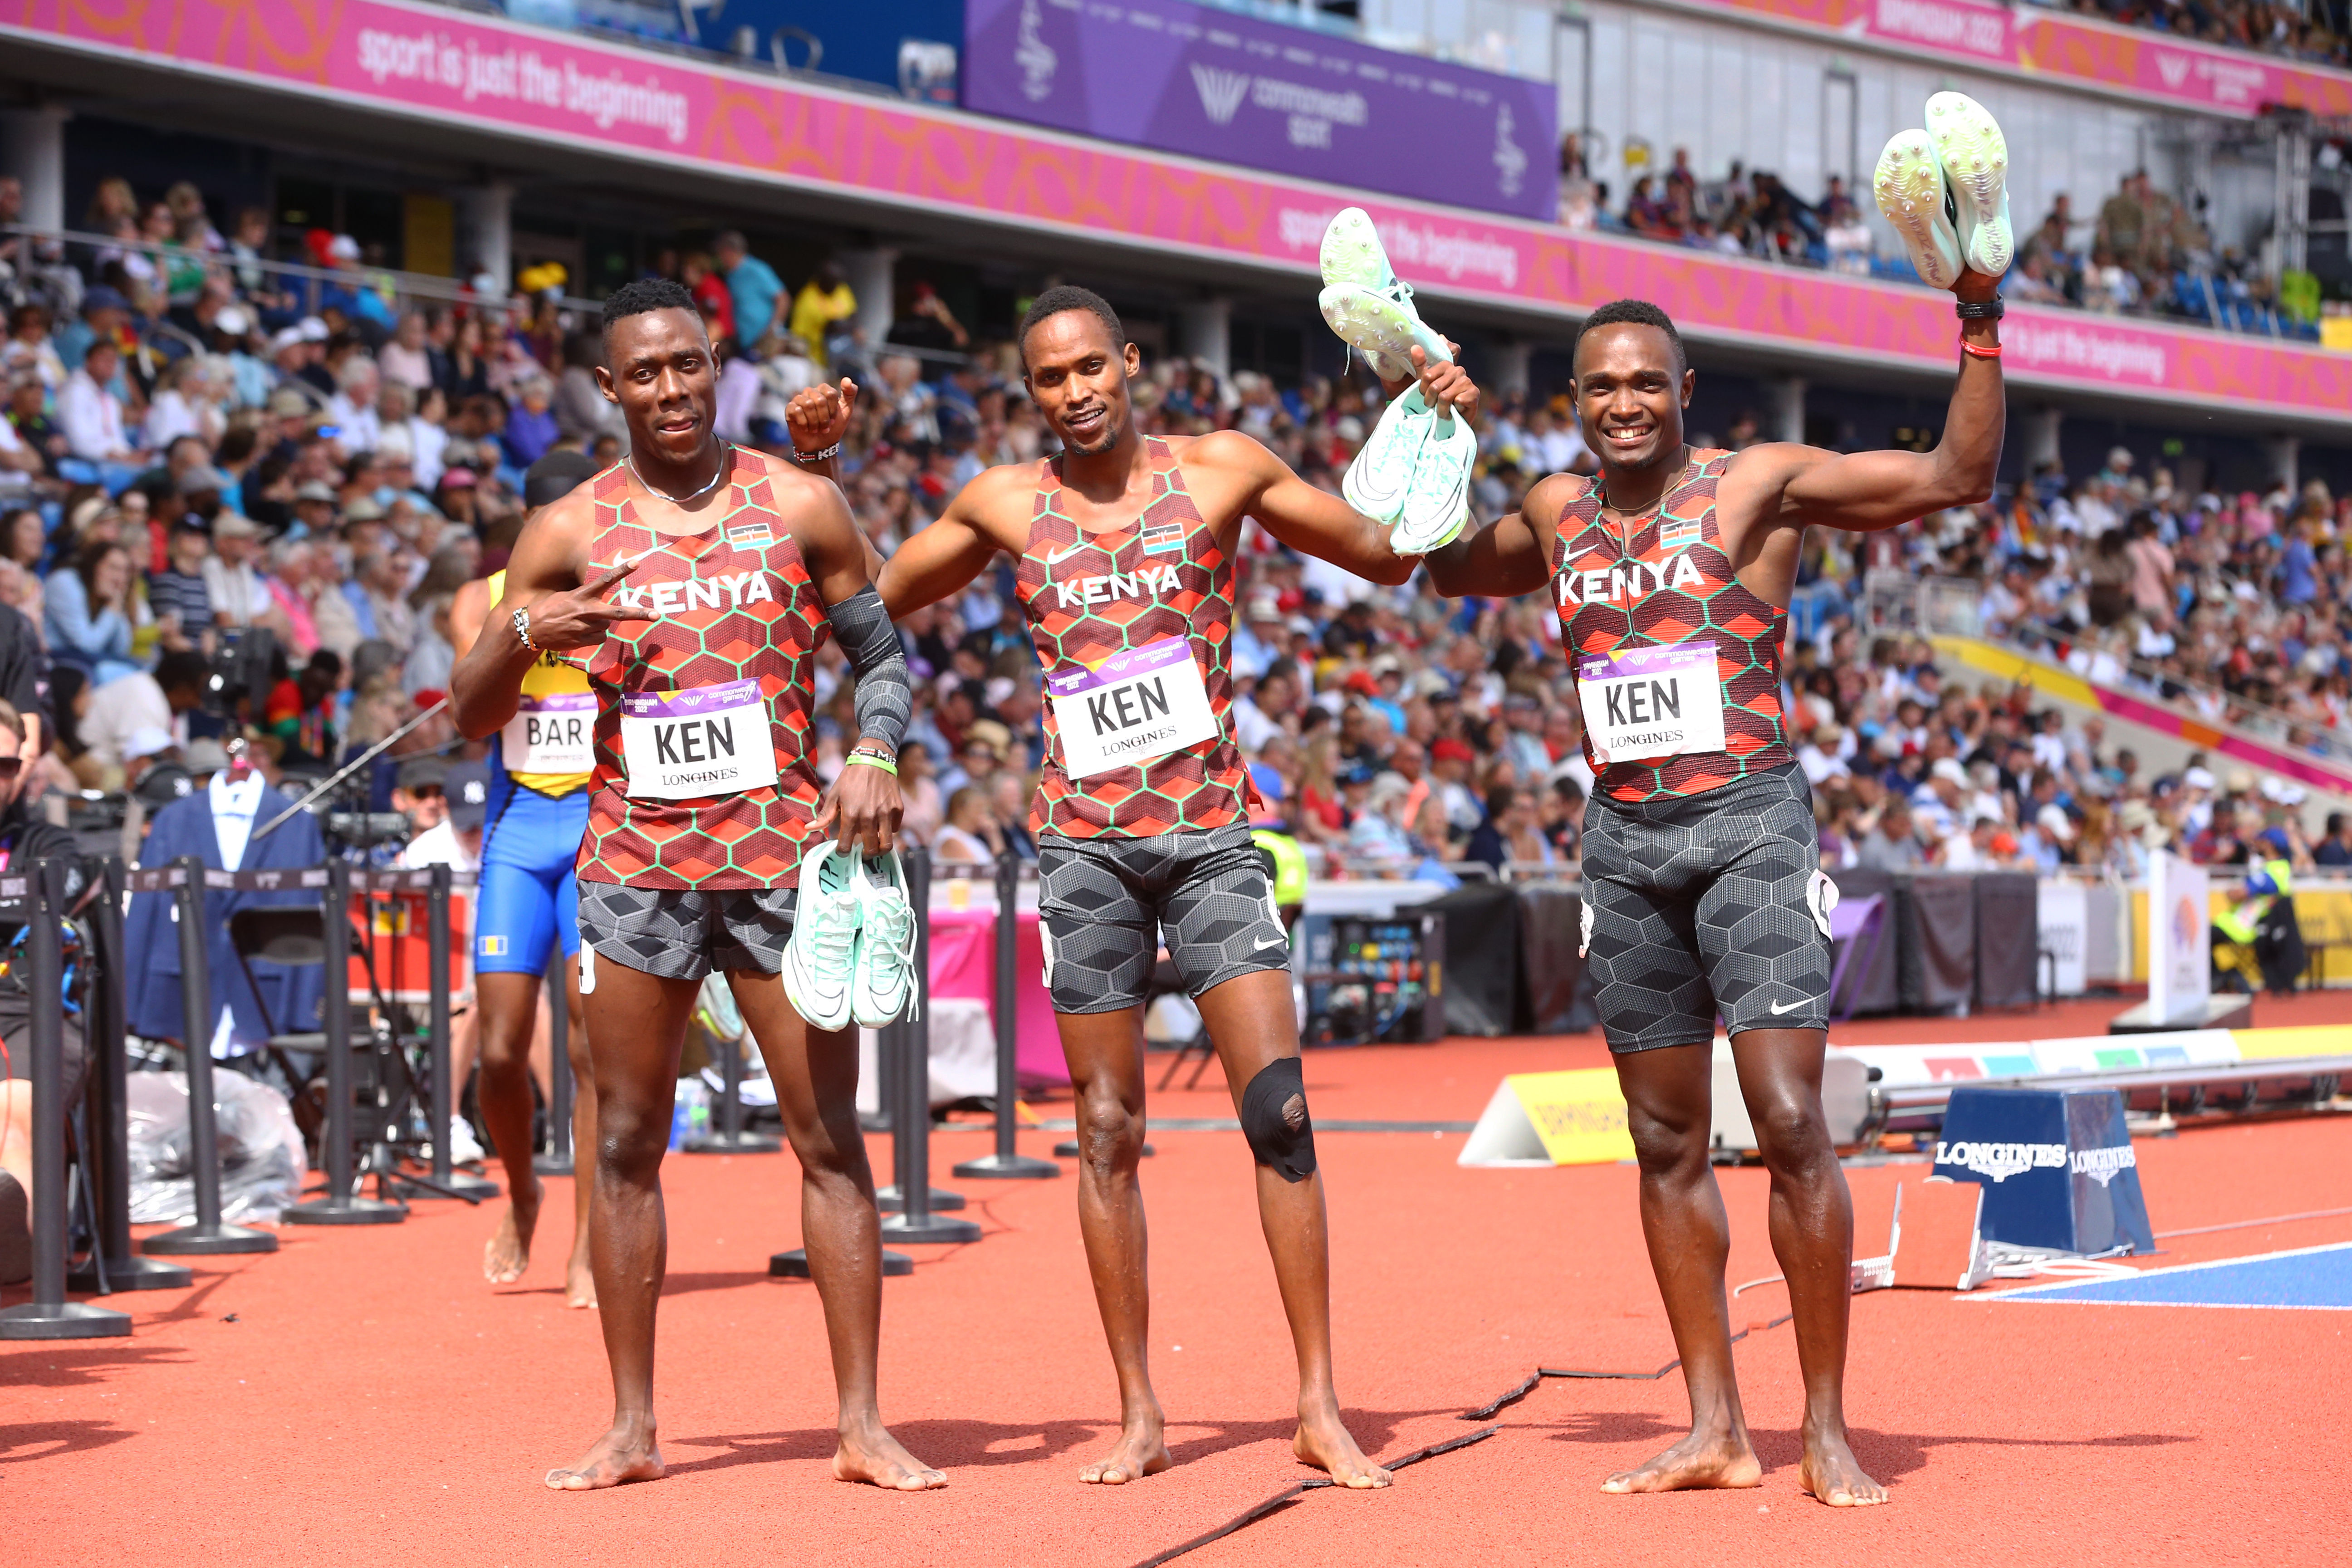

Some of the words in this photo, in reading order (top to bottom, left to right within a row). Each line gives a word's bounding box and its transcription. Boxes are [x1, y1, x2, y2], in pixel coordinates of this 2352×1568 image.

[357, 28, 436, 86] sport
[437, 30, 464, 88] is
[463, 37, 517, 103] just
[518, 50, 562, 108] the
[564, 57, 689, 144] beginning
[1425, 223, 1518, 289] beginning
[2089, 330, 2167, 384] beginning
[619, 570, 773, 615] KENYA
[1056, 564, 1183, 608] KENYA
[1559, 554, 1705, 606] KENYA
[1134, 641, 1185, 662] commonwealth
[1150, 651, 1173, 664] games
[1583, 659, 1609, 670] BIRMINGHAM
[1655, 647, 1710, 659] commonwealth
[1670, 655, 1695, 665] games
[1054, 671, 1088, 687] BIRMINGHAM
[1592, 667, 1602, 676] 2022
[708, 682, 756, 699] commonwea
[722, 693, 745, 704] games
[1066, 680, 1079, 691] 2022
[1087, 676, 1171, 736] KEN
[1605, 678, 1681, 727] KEN
[527, 718, 583, 745] BAR
[654, 716, 735, 764] KEN
[1102, 725, 1177, 756] LONGINES
[1610, 730, 1684, 749] LONGINES
[662, 767, 739, 786] LONGINES
[1935, 1141, 2067, 1168] LONGINES
[2069, 1144, 2136, 1174] LONGINES
